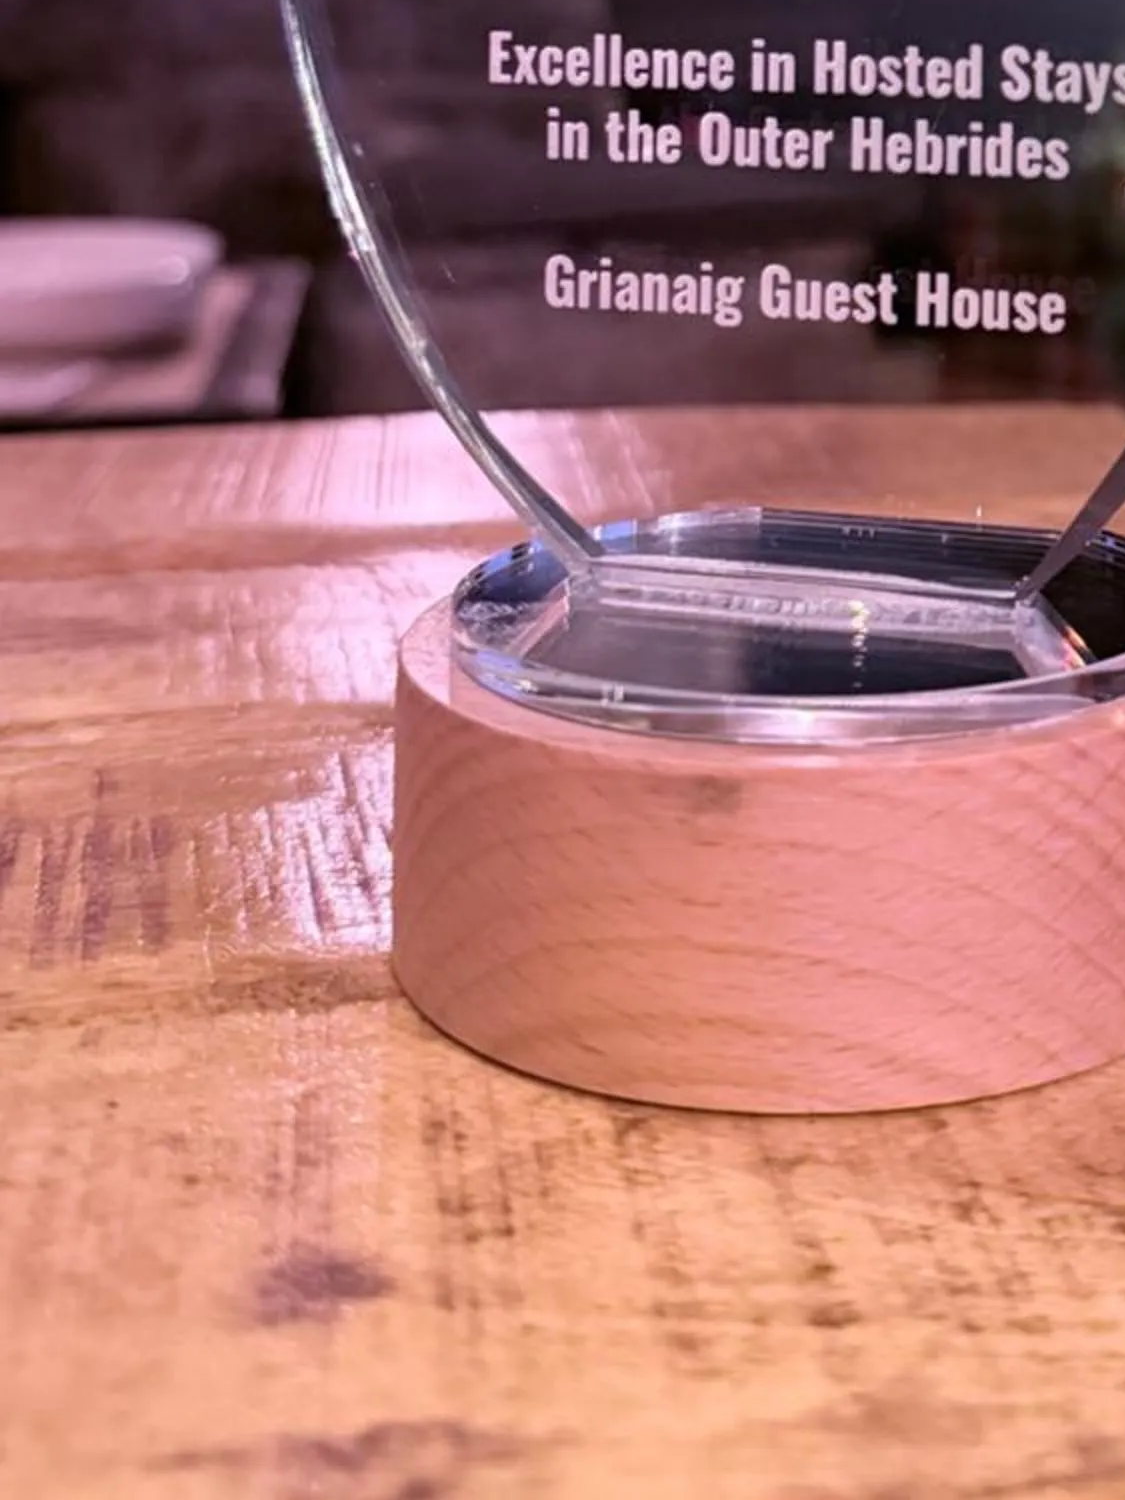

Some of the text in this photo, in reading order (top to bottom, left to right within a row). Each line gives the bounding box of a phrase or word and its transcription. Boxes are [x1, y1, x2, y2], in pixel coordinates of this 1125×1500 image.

[488, 30, 735, 92] Excellence
[751, 38, 795, 93] in
[813, 40, 984, 100] Hosted
[546, 107, 1070, 180] in the Outer Hebrides
[544, 254, 1067, 334] Grianaig Guest House
